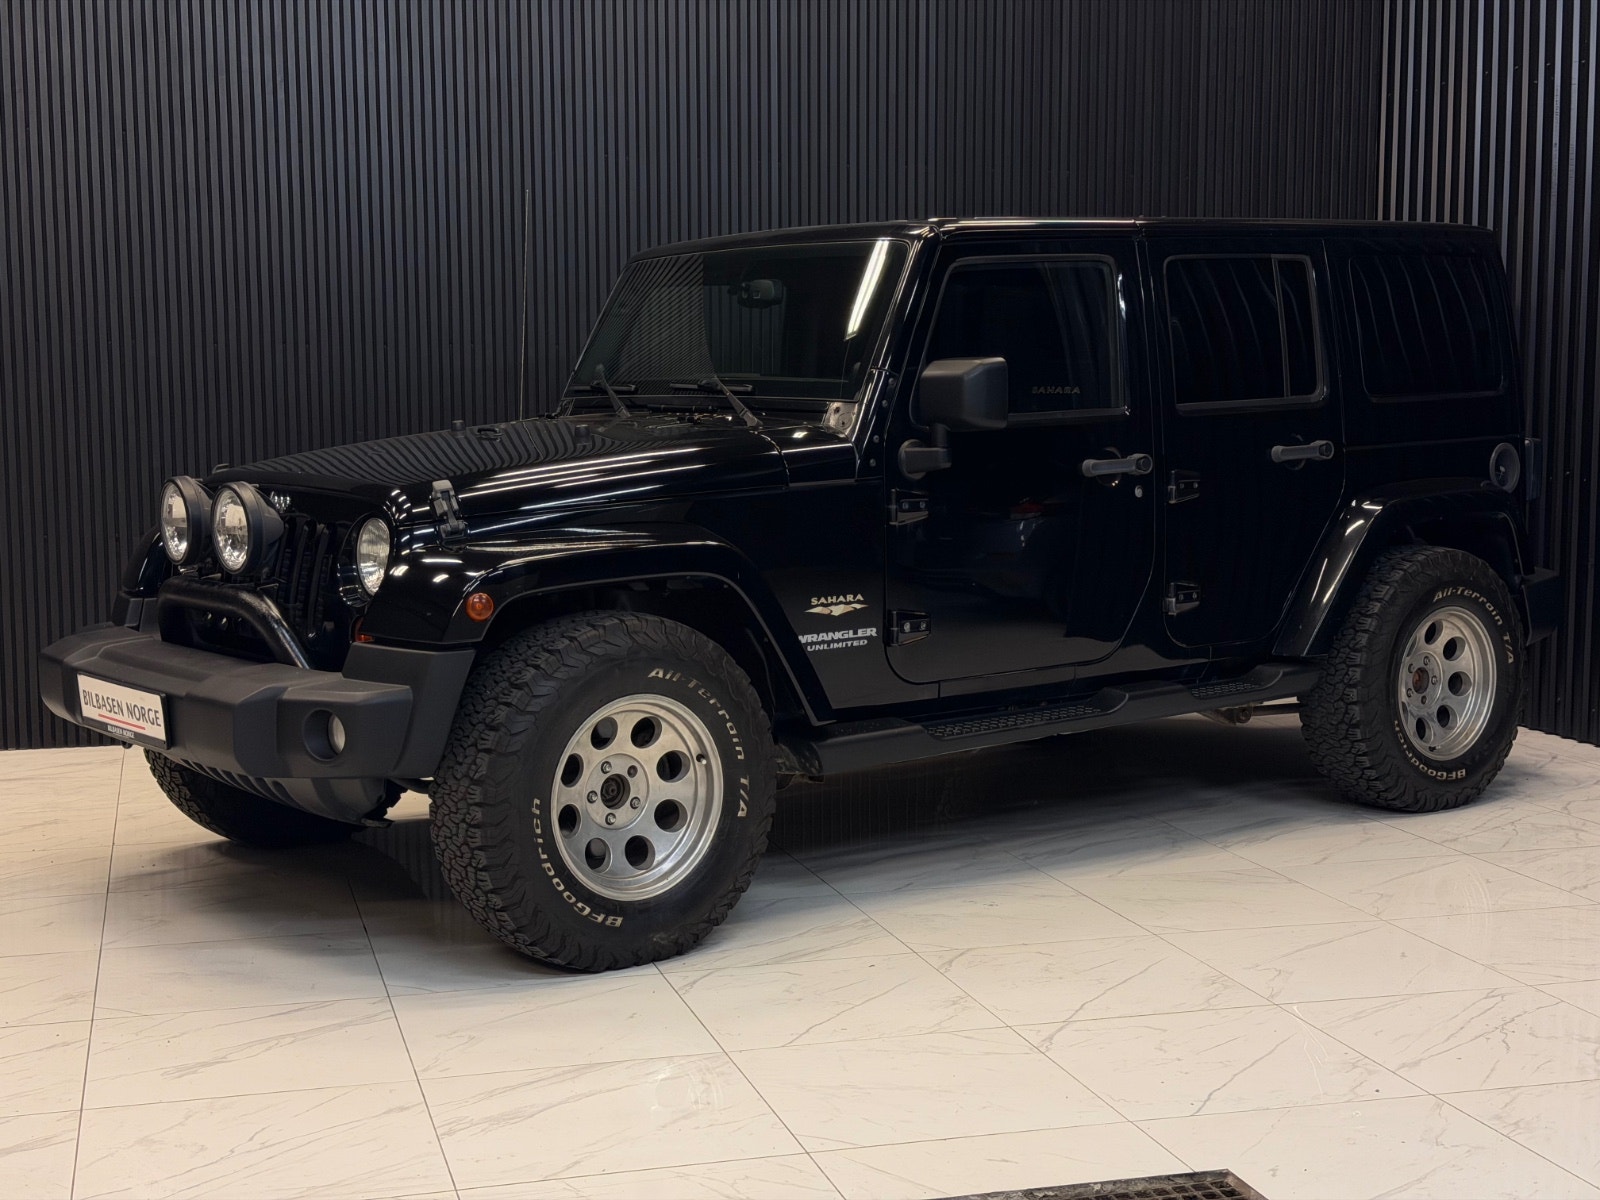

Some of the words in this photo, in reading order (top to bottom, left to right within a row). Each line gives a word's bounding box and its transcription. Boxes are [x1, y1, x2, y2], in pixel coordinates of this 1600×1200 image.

[810, 593, 864, 606] SAHARA
[1433, 586, 1503, 626] All-Terrain
[1503, 632, 1515, 664] T/A
[806, 639, 869, 652] UNLIMITED
[82, 689, 125, 717] BILBASEN
[125, 702, 162, 727] NORGE
[647, 667, 745, 760] All-Terrain
[737, 775, 750, 818] T/A
[1394, 719, 1467, 781] BFGoodrich
[532, 798, 624, 928] BFGoodrich
